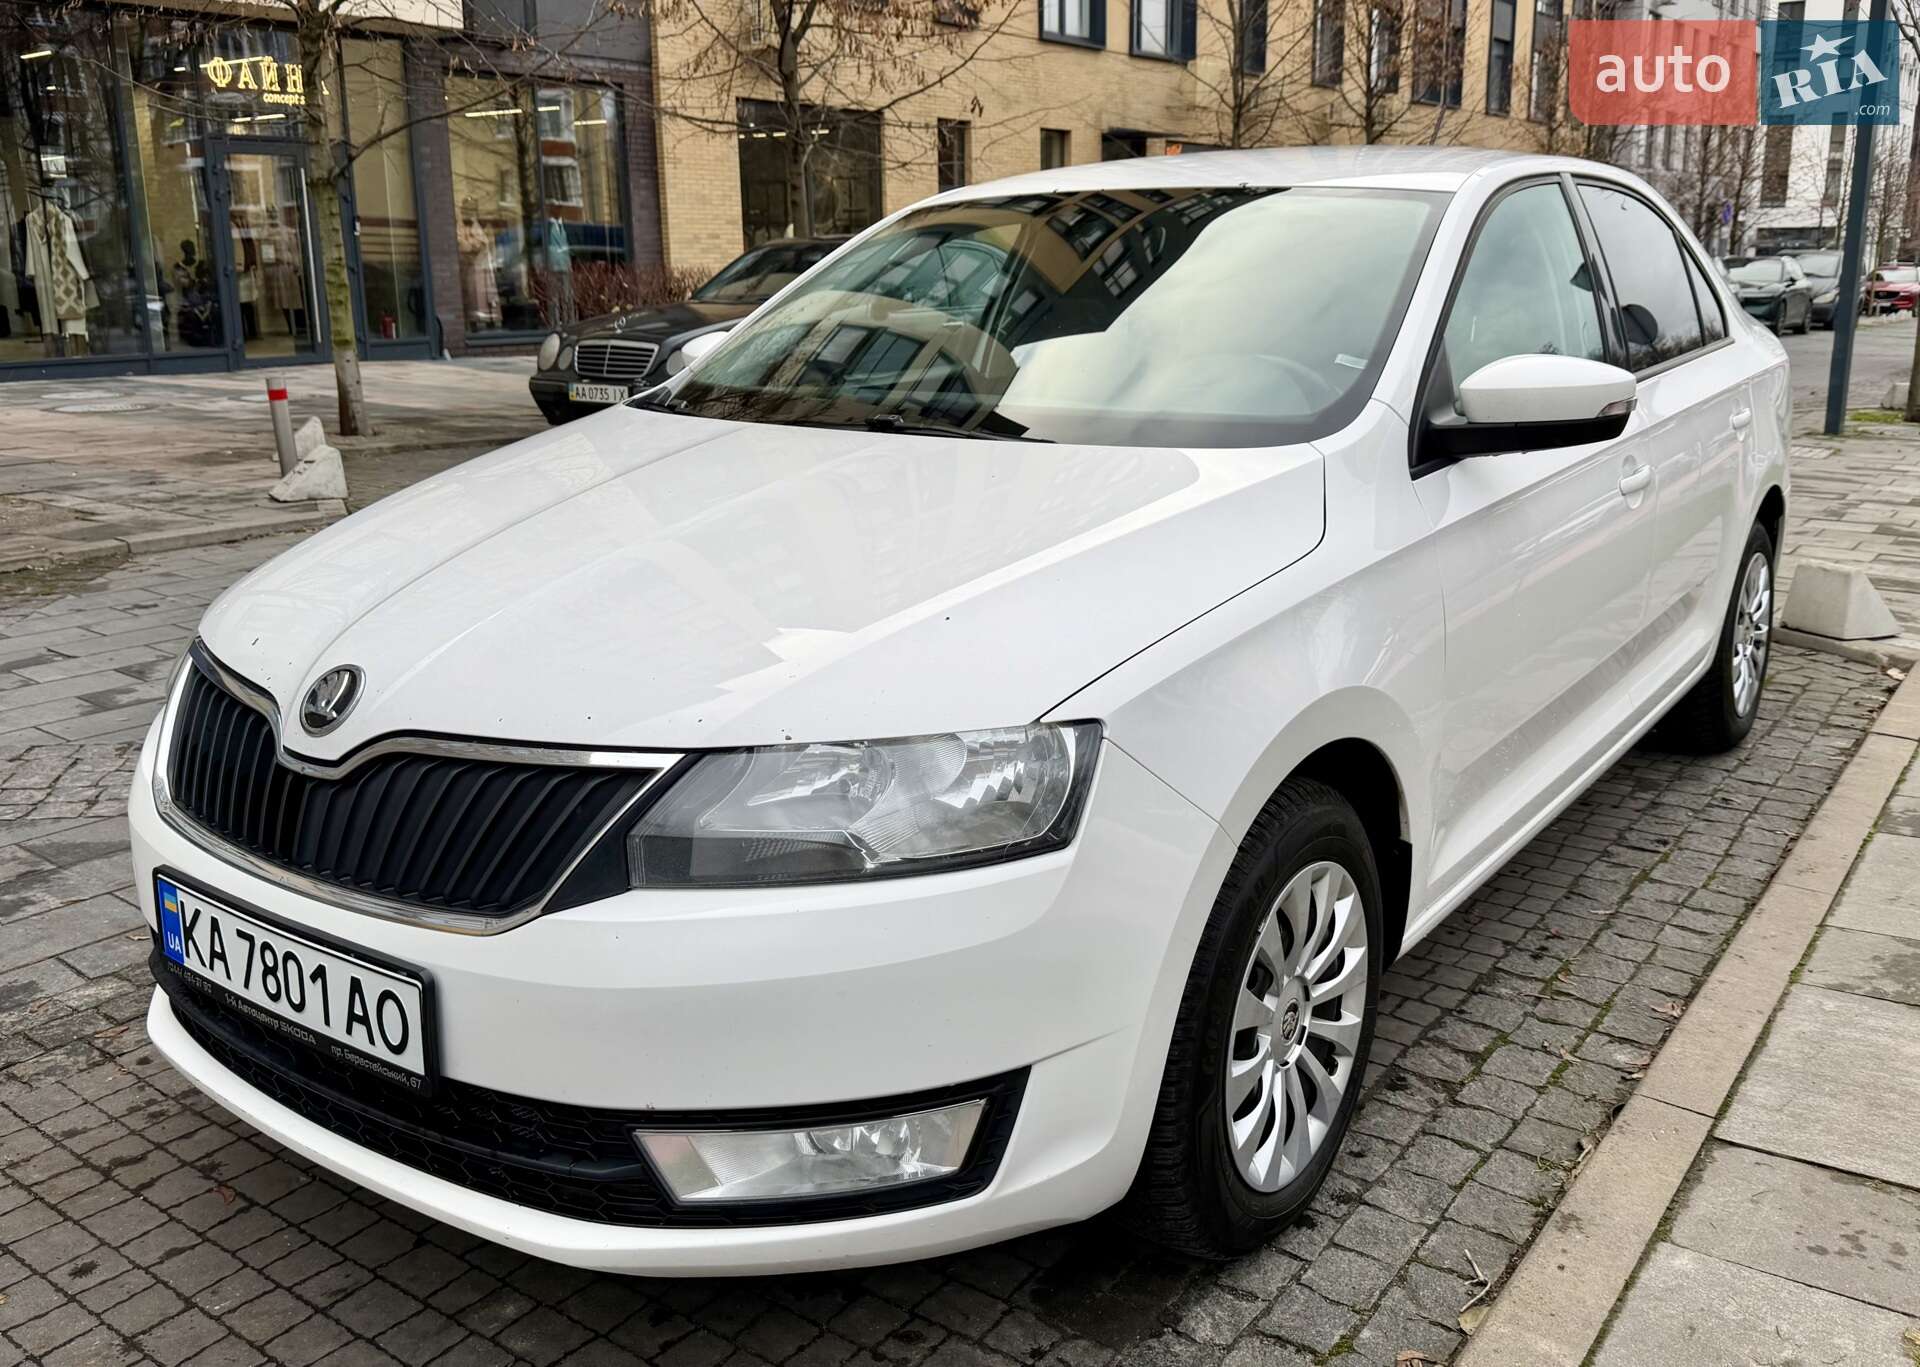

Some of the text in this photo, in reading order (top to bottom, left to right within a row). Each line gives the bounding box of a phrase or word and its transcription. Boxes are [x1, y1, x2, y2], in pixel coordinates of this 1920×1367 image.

[207, 56, 329, 95] ФАЙН
[575, 385, 625, 401] AA 0735 IX
[167, 931, 182, 954] UA
[180, 899, 232, 981] KA
[235, 927, 331, 1028] 7801
[345, 975, 410, 1056] AO
